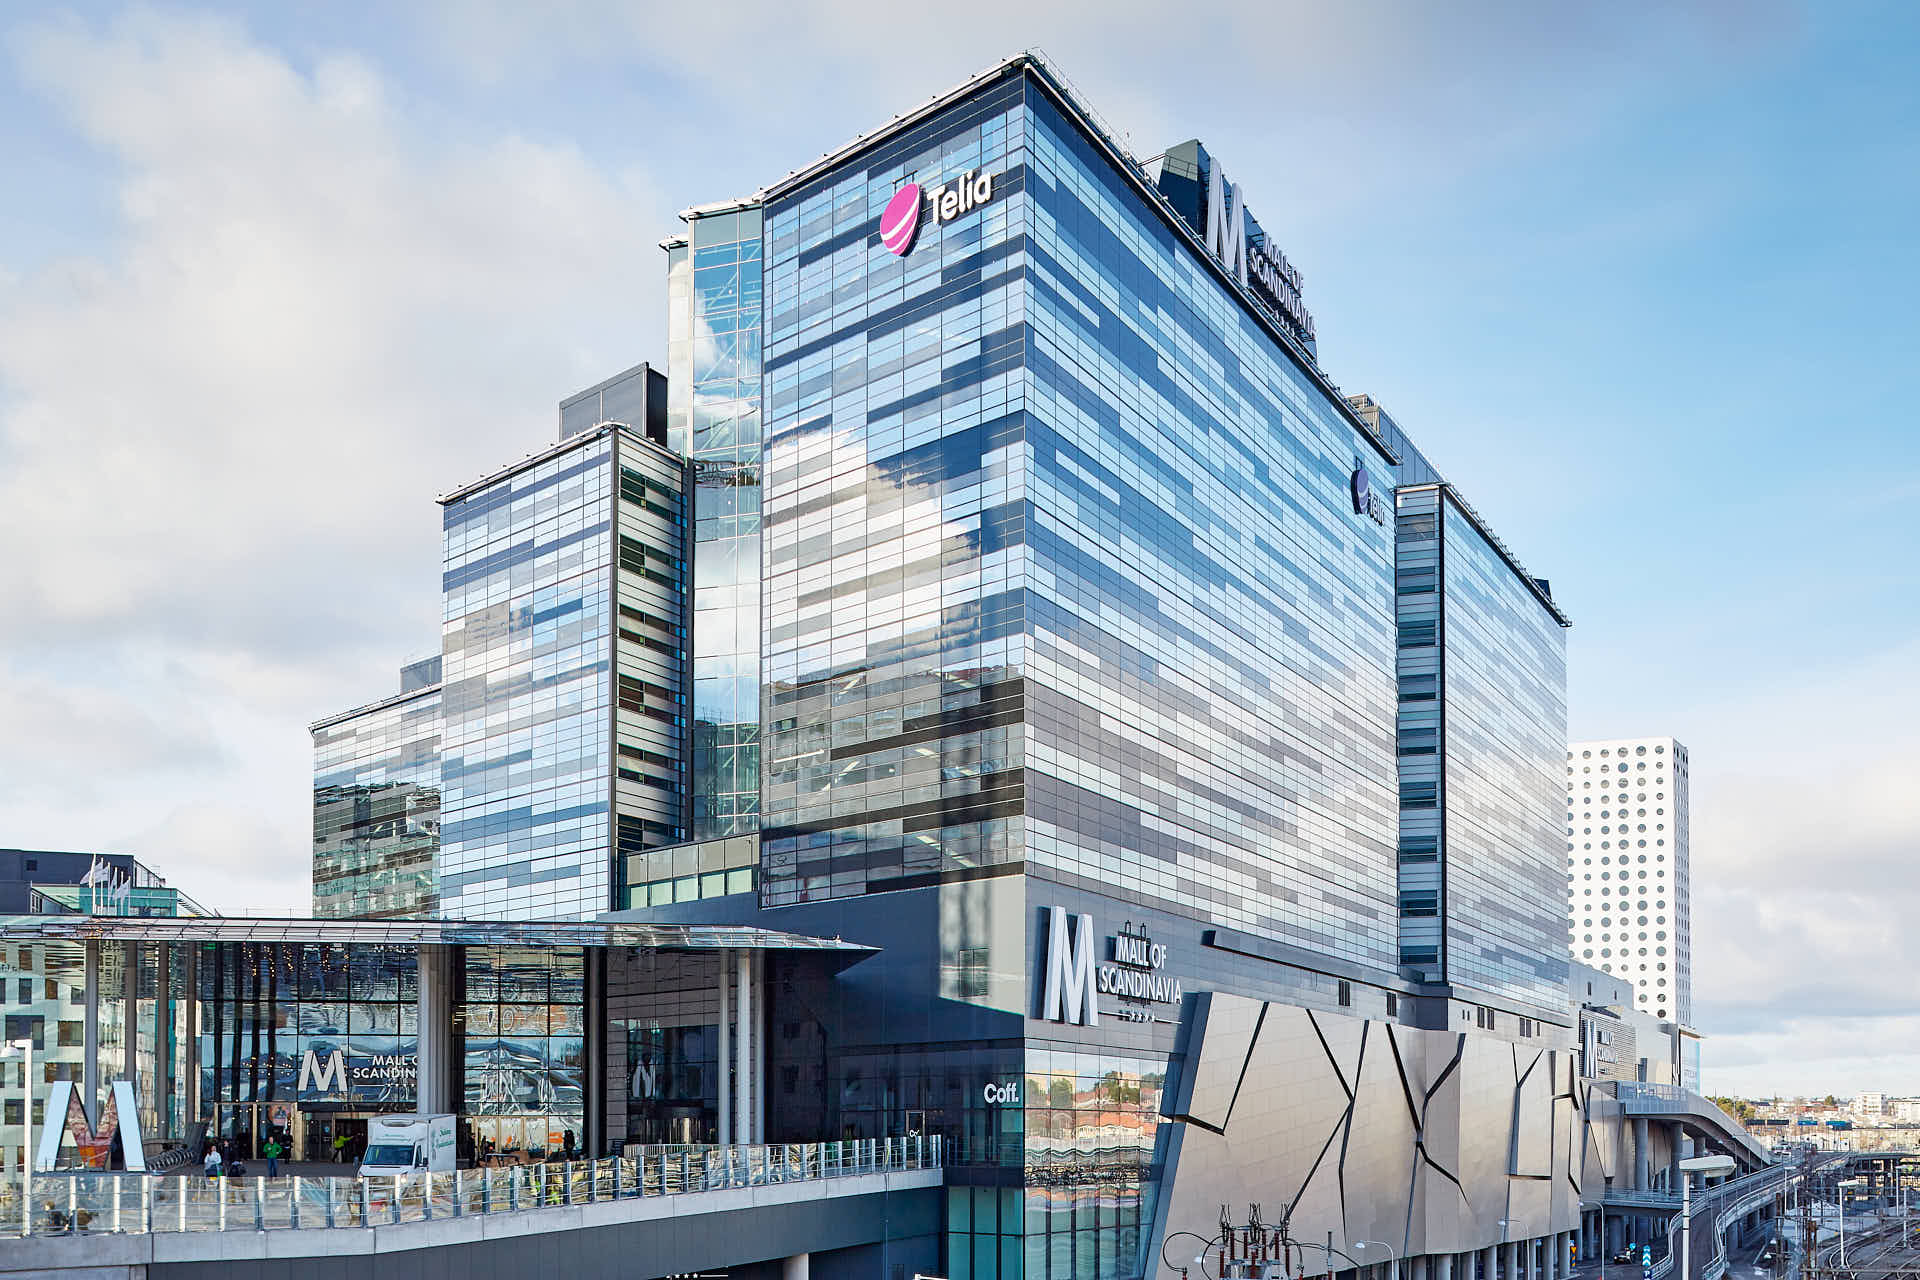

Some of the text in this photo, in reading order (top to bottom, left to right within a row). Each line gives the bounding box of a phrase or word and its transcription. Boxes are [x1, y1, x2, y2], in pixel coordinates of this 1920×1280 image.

[926, 169, 992, 225] Telia
[1207, 157, 1248, 287] M
[1043, 906, 1099, 1027] M
[1115, 935, 1167, 970] MALL OF
[1101, 966, 1183, 1005] SCANDINAVIA
[298, 1050, 348, 1092] M
[353, 1067, 416, 1079] SCANDIN
[372, 1055, 408, 1066] MALL
[984, 1082, 1019, 1104] Coff.
[35, 1081, 146, 1172] M
